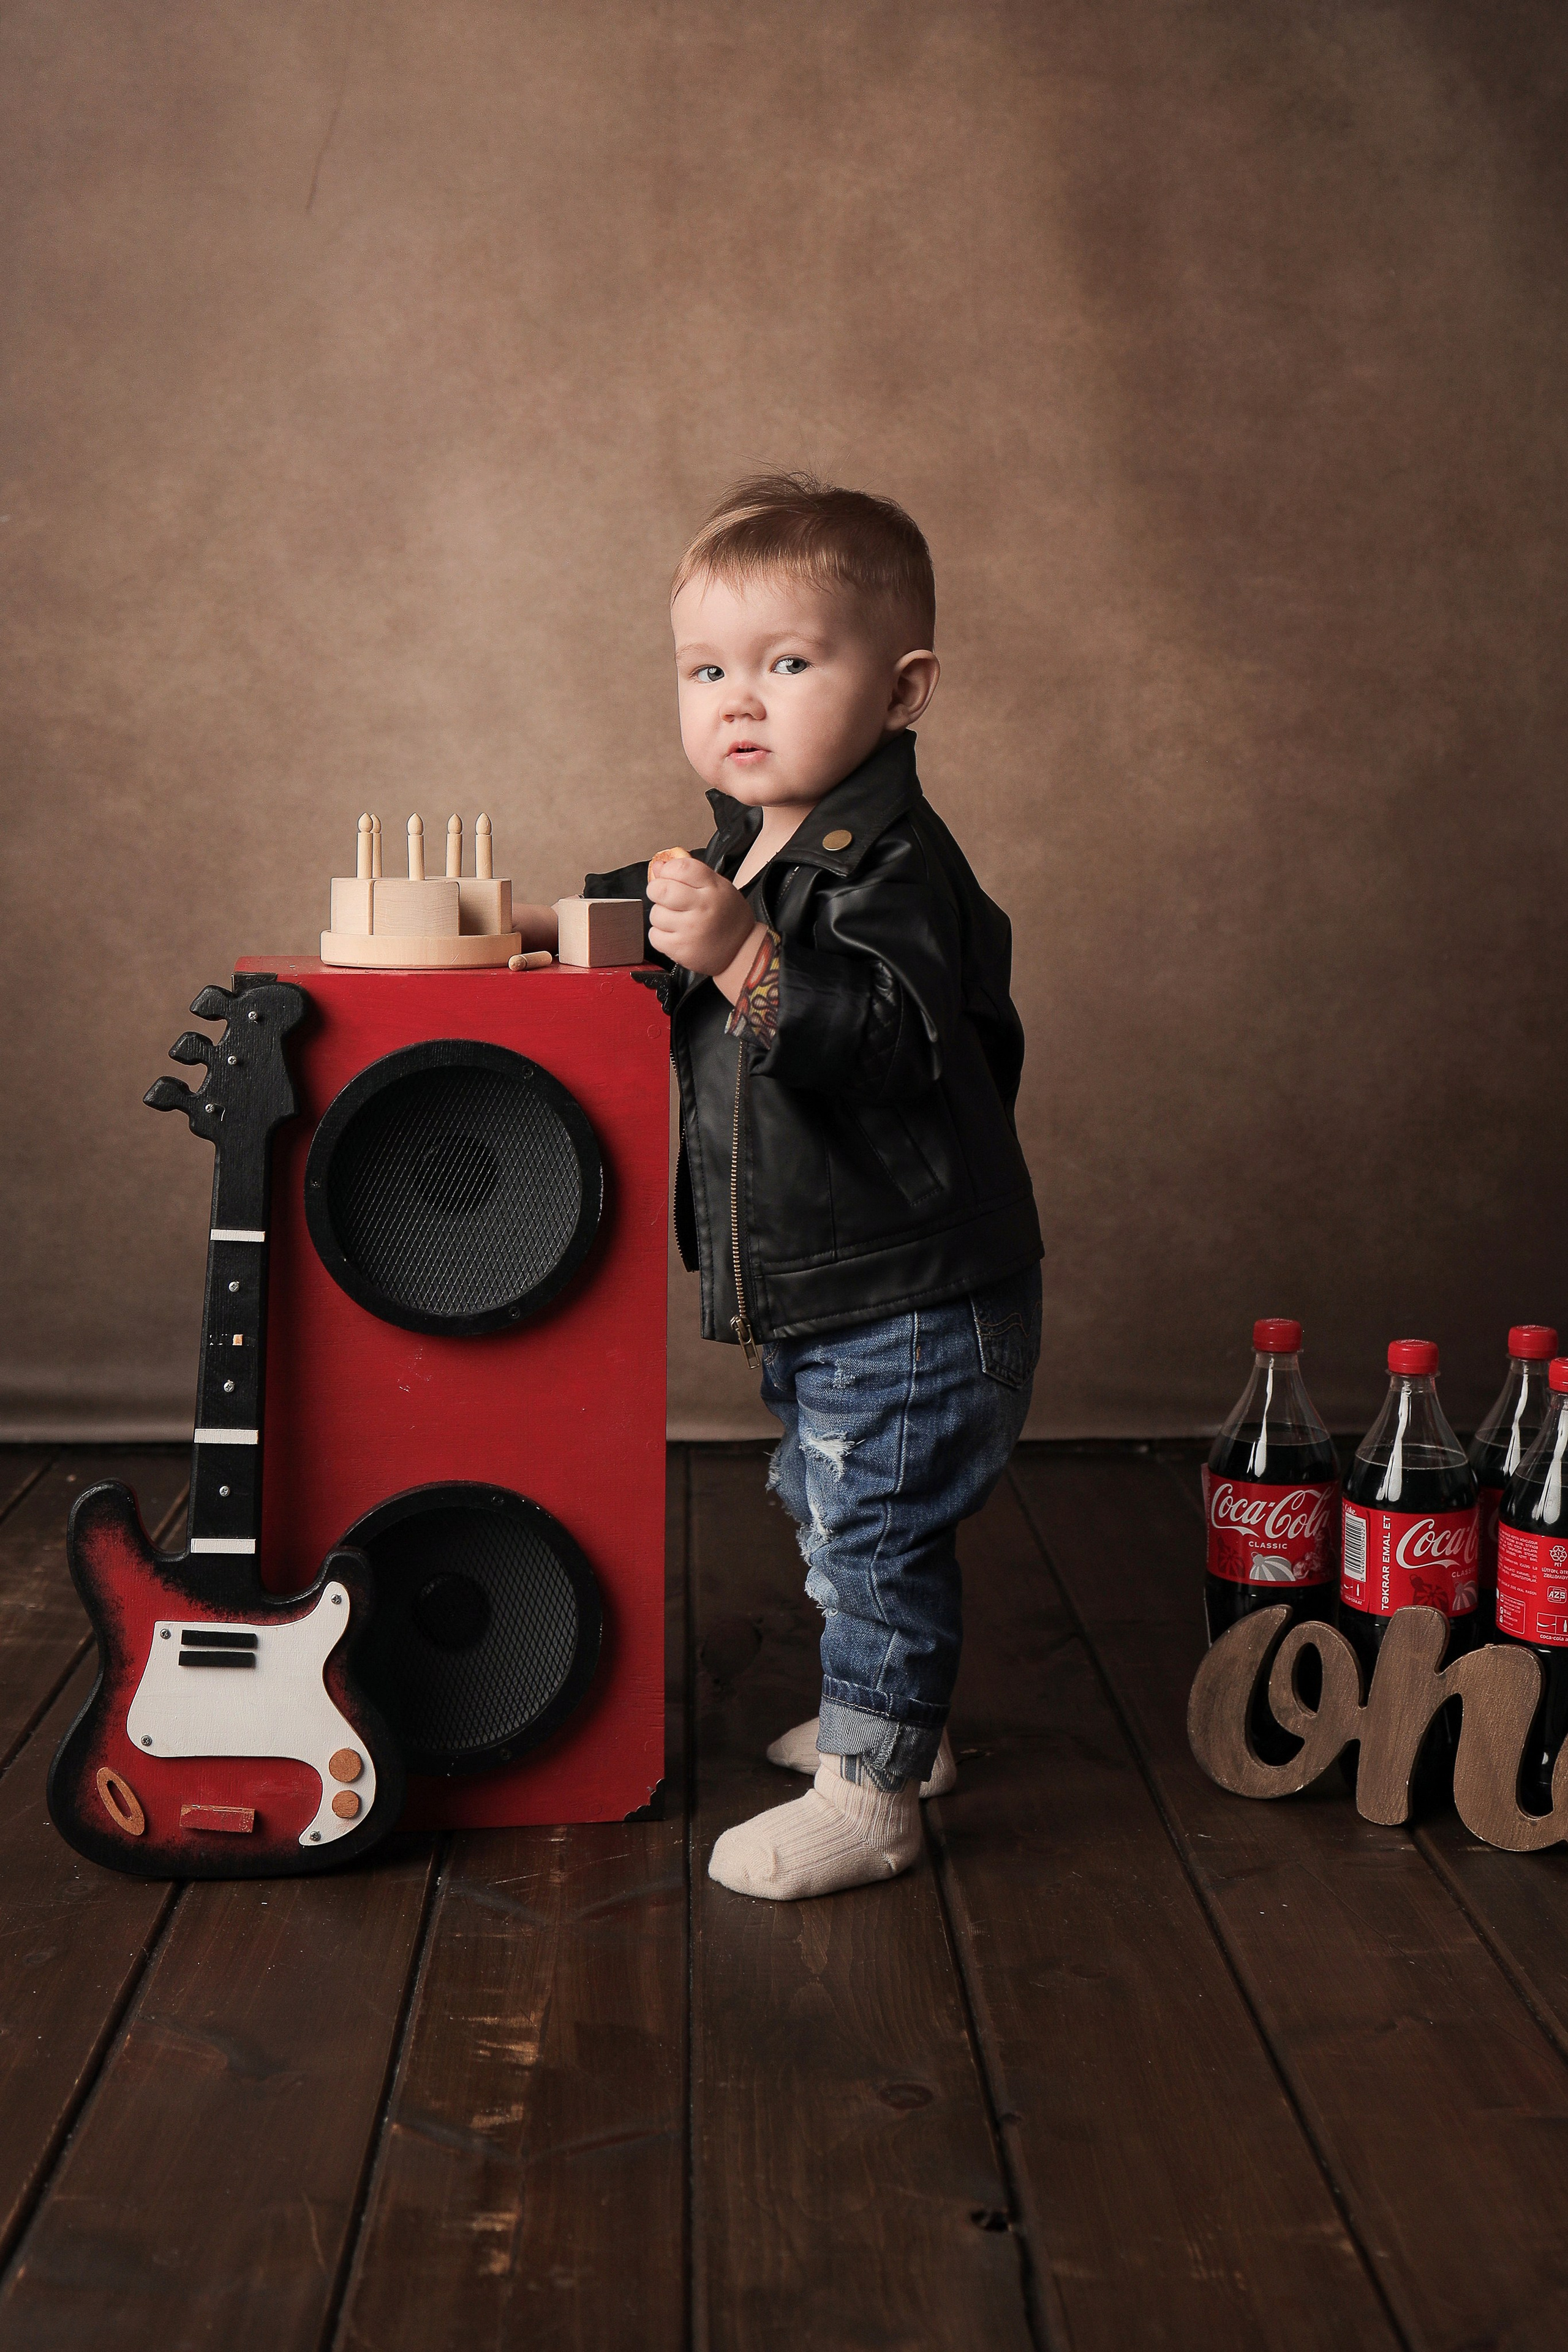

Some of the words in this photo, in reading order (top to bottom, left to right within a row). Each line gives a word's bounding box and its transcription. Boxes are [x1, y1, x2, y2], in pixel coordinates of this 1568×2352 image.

[1383, 1515, 1391, 1529] ET
[1381, 1566, 1390, 1610] TƏKRAR
[1548, 1591, 1566, 1599] AZS
[1187, 1604, 1568, 1851] on
